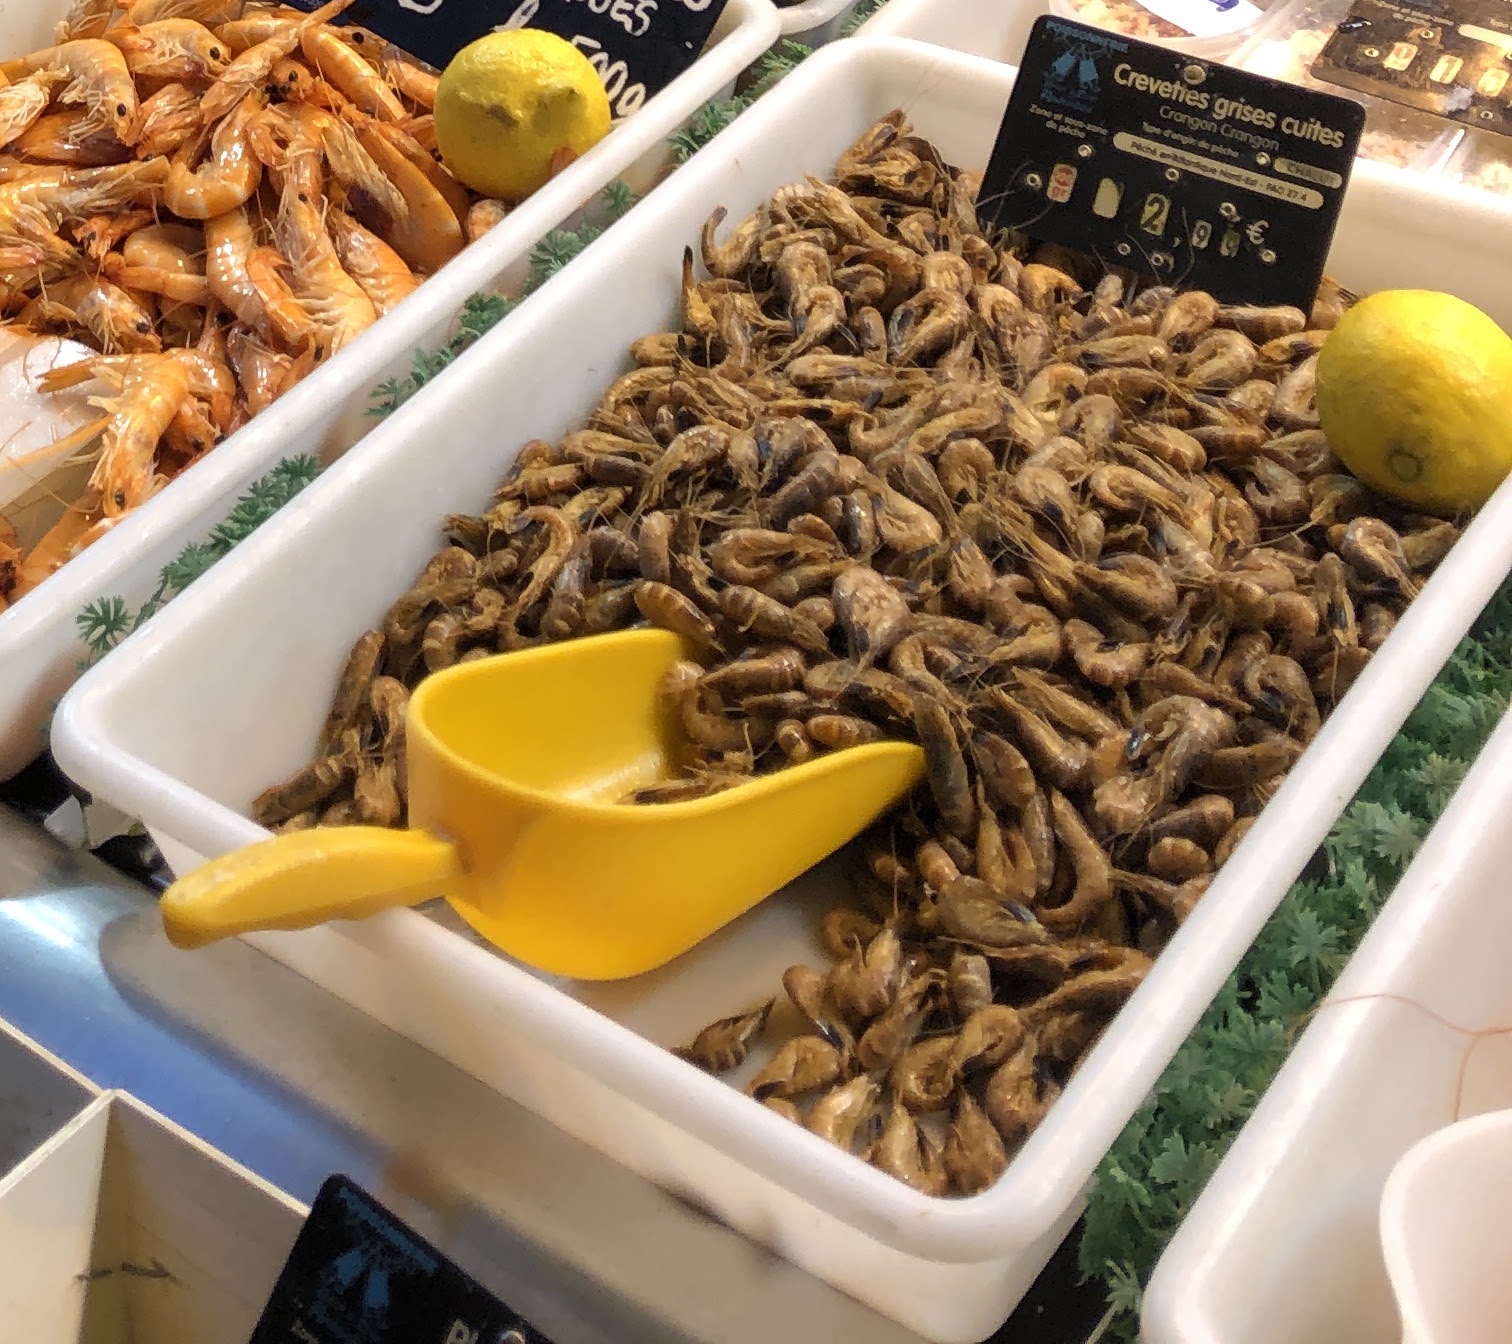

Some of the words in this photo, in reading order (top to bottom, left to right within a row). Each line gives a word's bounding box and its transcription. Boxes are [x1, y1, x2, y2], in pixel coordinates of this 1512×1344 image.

[1113, 63, 1210, 110] Crevettes
[1214, 97, 1276, 130] grises
[1281, 115, 1345, 149] cuites
[1159, 104, 1218, 133] Crangon
[1220, 121, 1279, 152] Crangon
